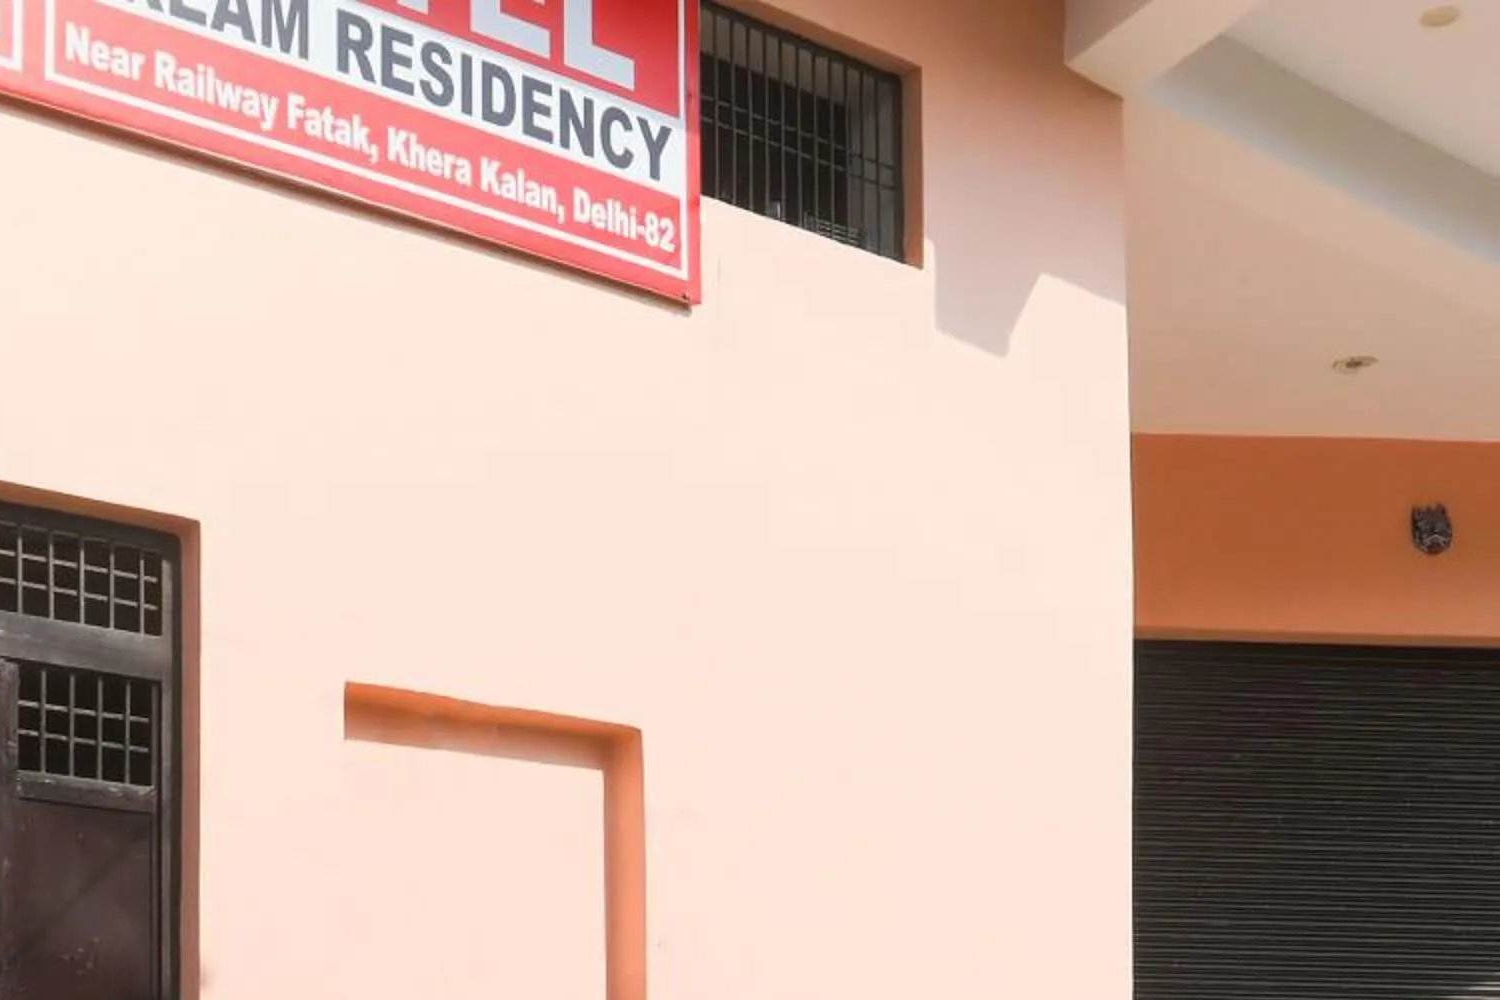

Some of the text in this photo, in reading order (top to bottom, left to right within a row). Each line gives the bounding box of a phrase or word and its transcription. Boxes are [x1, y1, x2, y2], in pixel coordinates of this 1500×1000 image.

[64, 20, 676, 252] Near Railway Fatak, Khera Kalan, Delhi-82
[336, 8, 672, 181] RESIDENCY
